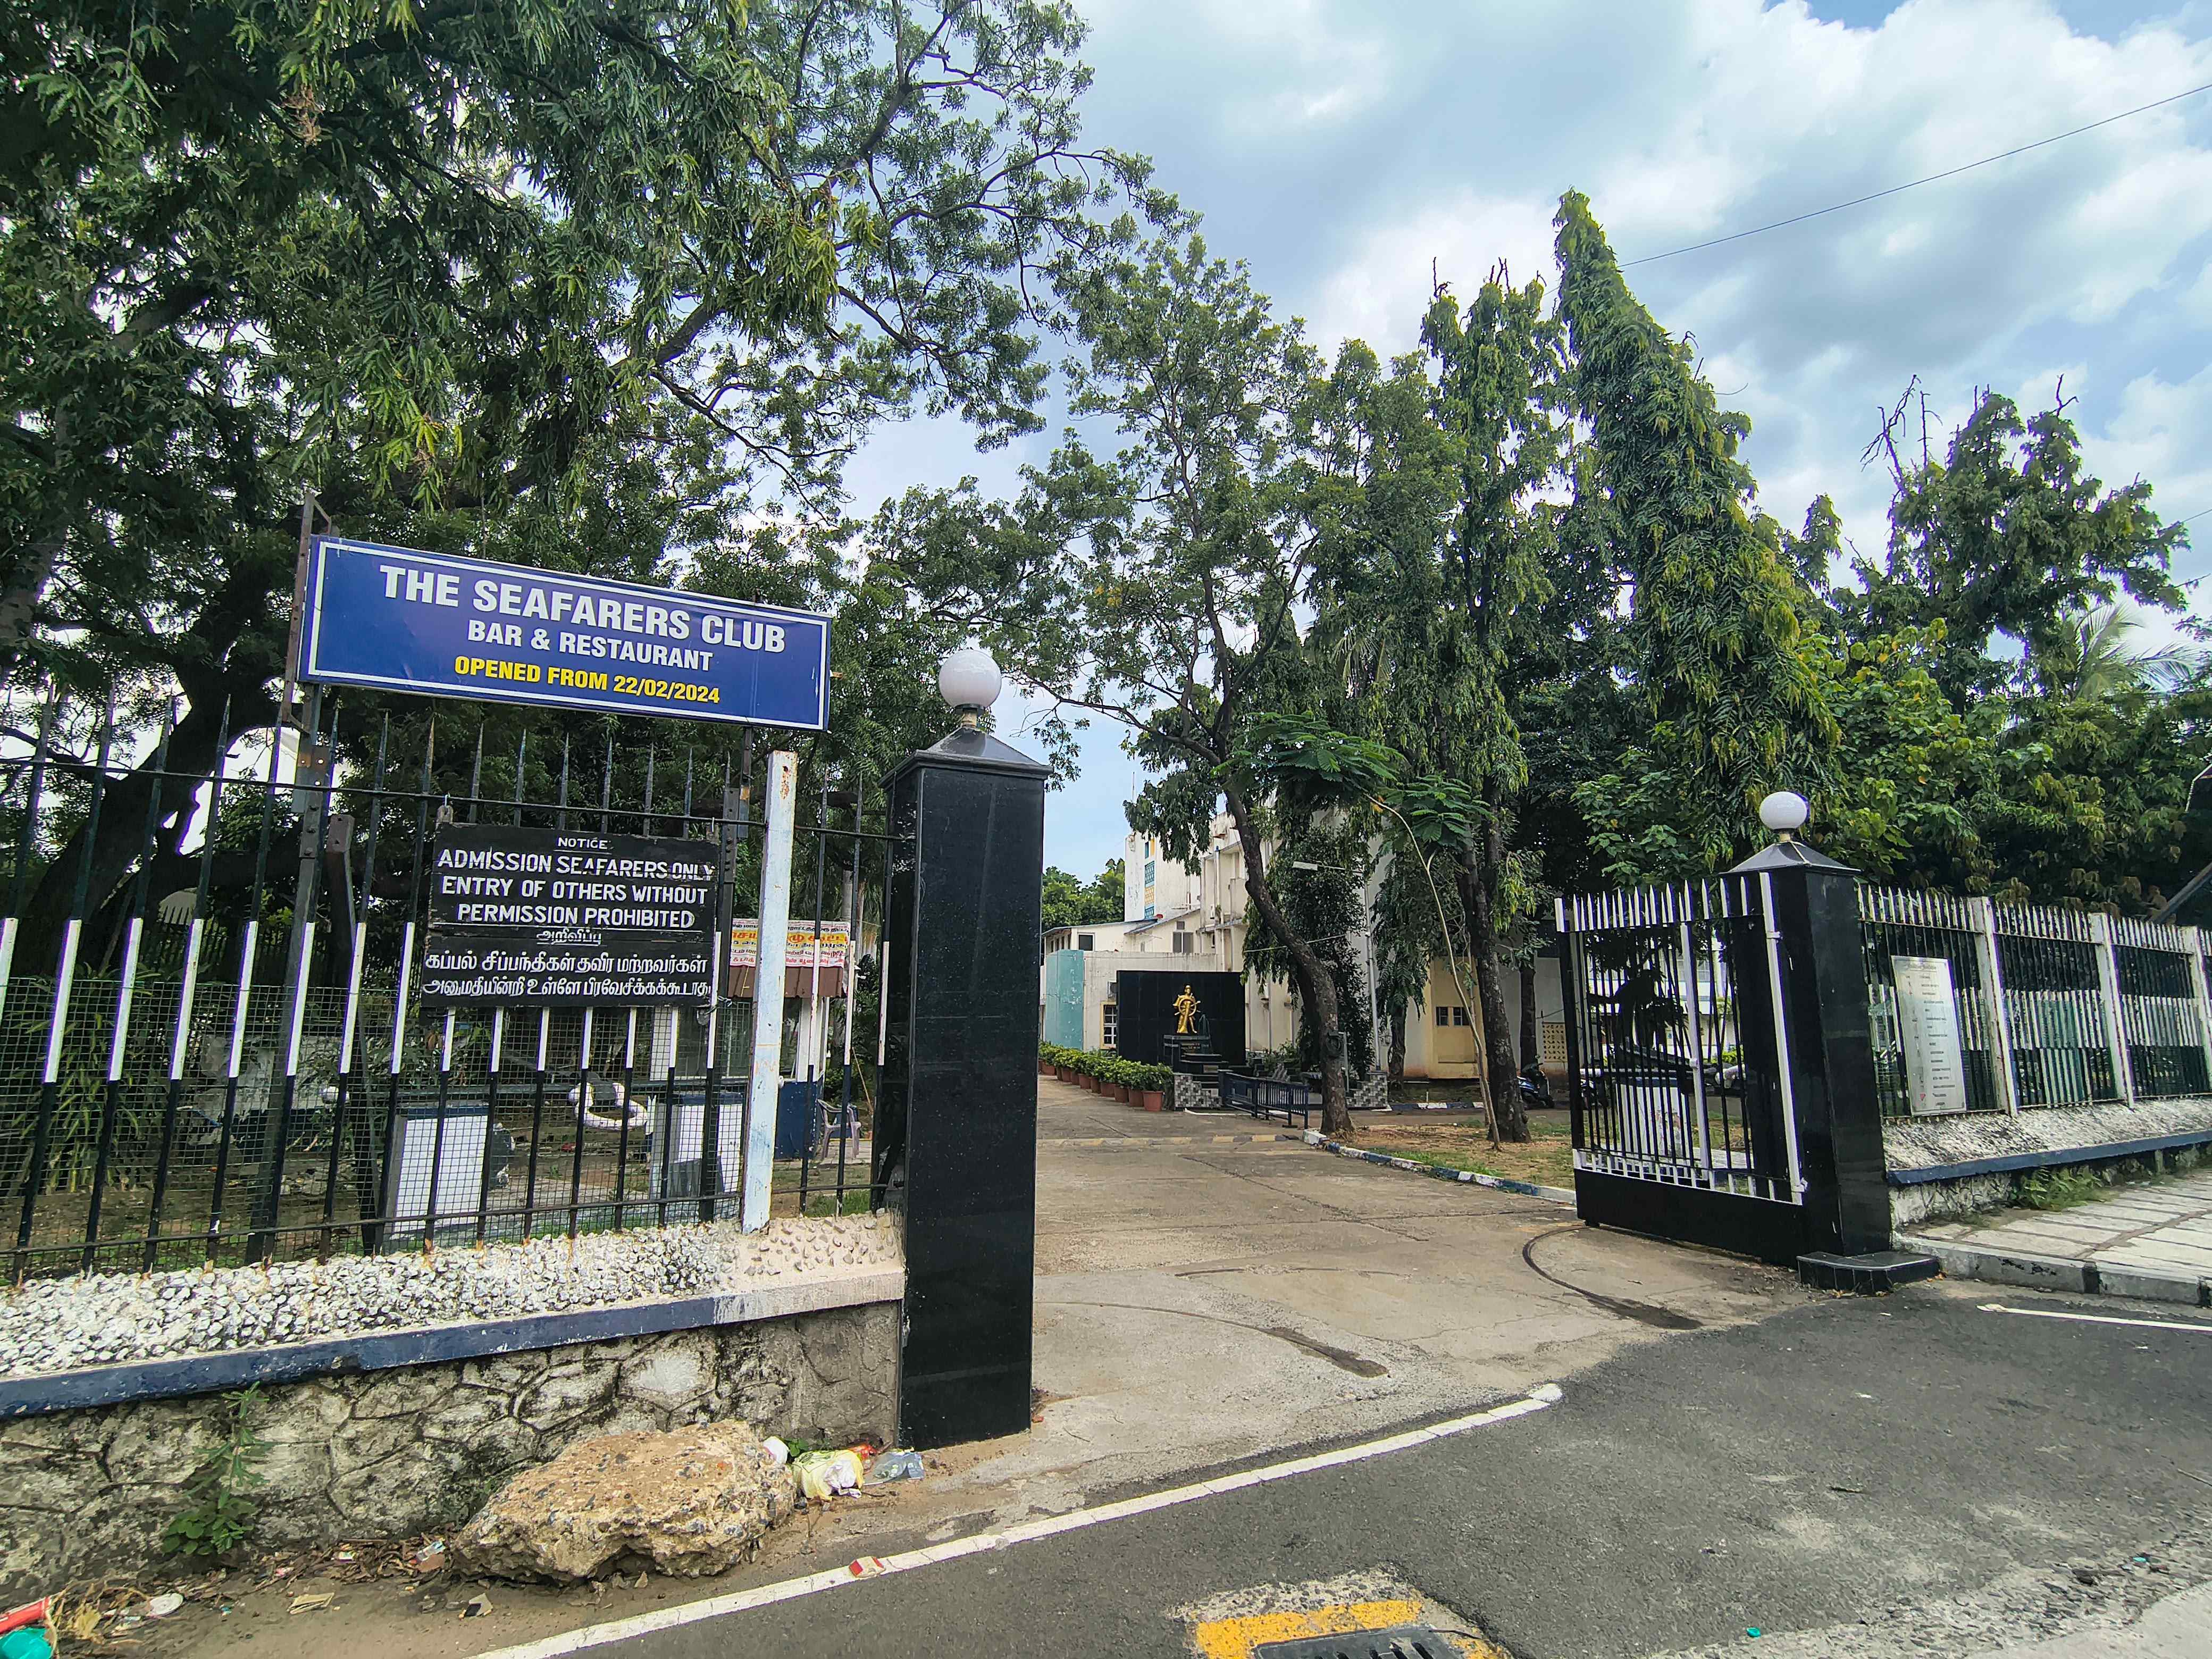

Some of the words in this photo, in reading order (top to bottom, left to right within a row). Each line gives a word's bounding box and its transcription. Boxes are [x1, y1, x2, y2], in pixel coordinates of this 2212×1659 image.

[380, 565, 459, 607] THE
[473, 580, 690, 639] SEAFARERS
[701, 615, 785, 653] CLUB
[468, 619, 522, 647] BAR
[531, 628, 550, 650] &
[559, 632, 713, 671] RESTAURANT
[455, 656, 540, 682] OPENED
[548, 667, 607, 690] FROM
[613, 675, 720, 703] 22/02/2024
[558, 837, 608, 850] NOTICE
[438, 849, 552, 873] ADMISSION
[556, 856, 668, 878] SEAFARERS
[671, 862, 716, 881] ONLY
[442, 876, 513, 896] ENTRY
[522, 879, 546, 898] OF
[552, 881, 626, 901] OTHERS
[632, 885, 708, 904] WITHOUT
[458, 903, 578, 925] PERMISSION
[584, 907, 696, 928] PROHIBITED
[425, 950, 477, 970] கப்பல்
[481, 951, 576, 973] சிப்பந்திகள்
[575, 952, 615, 973] தவிர
[617, 954, 708, 974] மற்றவர்கள்
[422, 975, 525, 997] அனுமதியின்றி
[527, 976, 581, 996] உள்ளே
